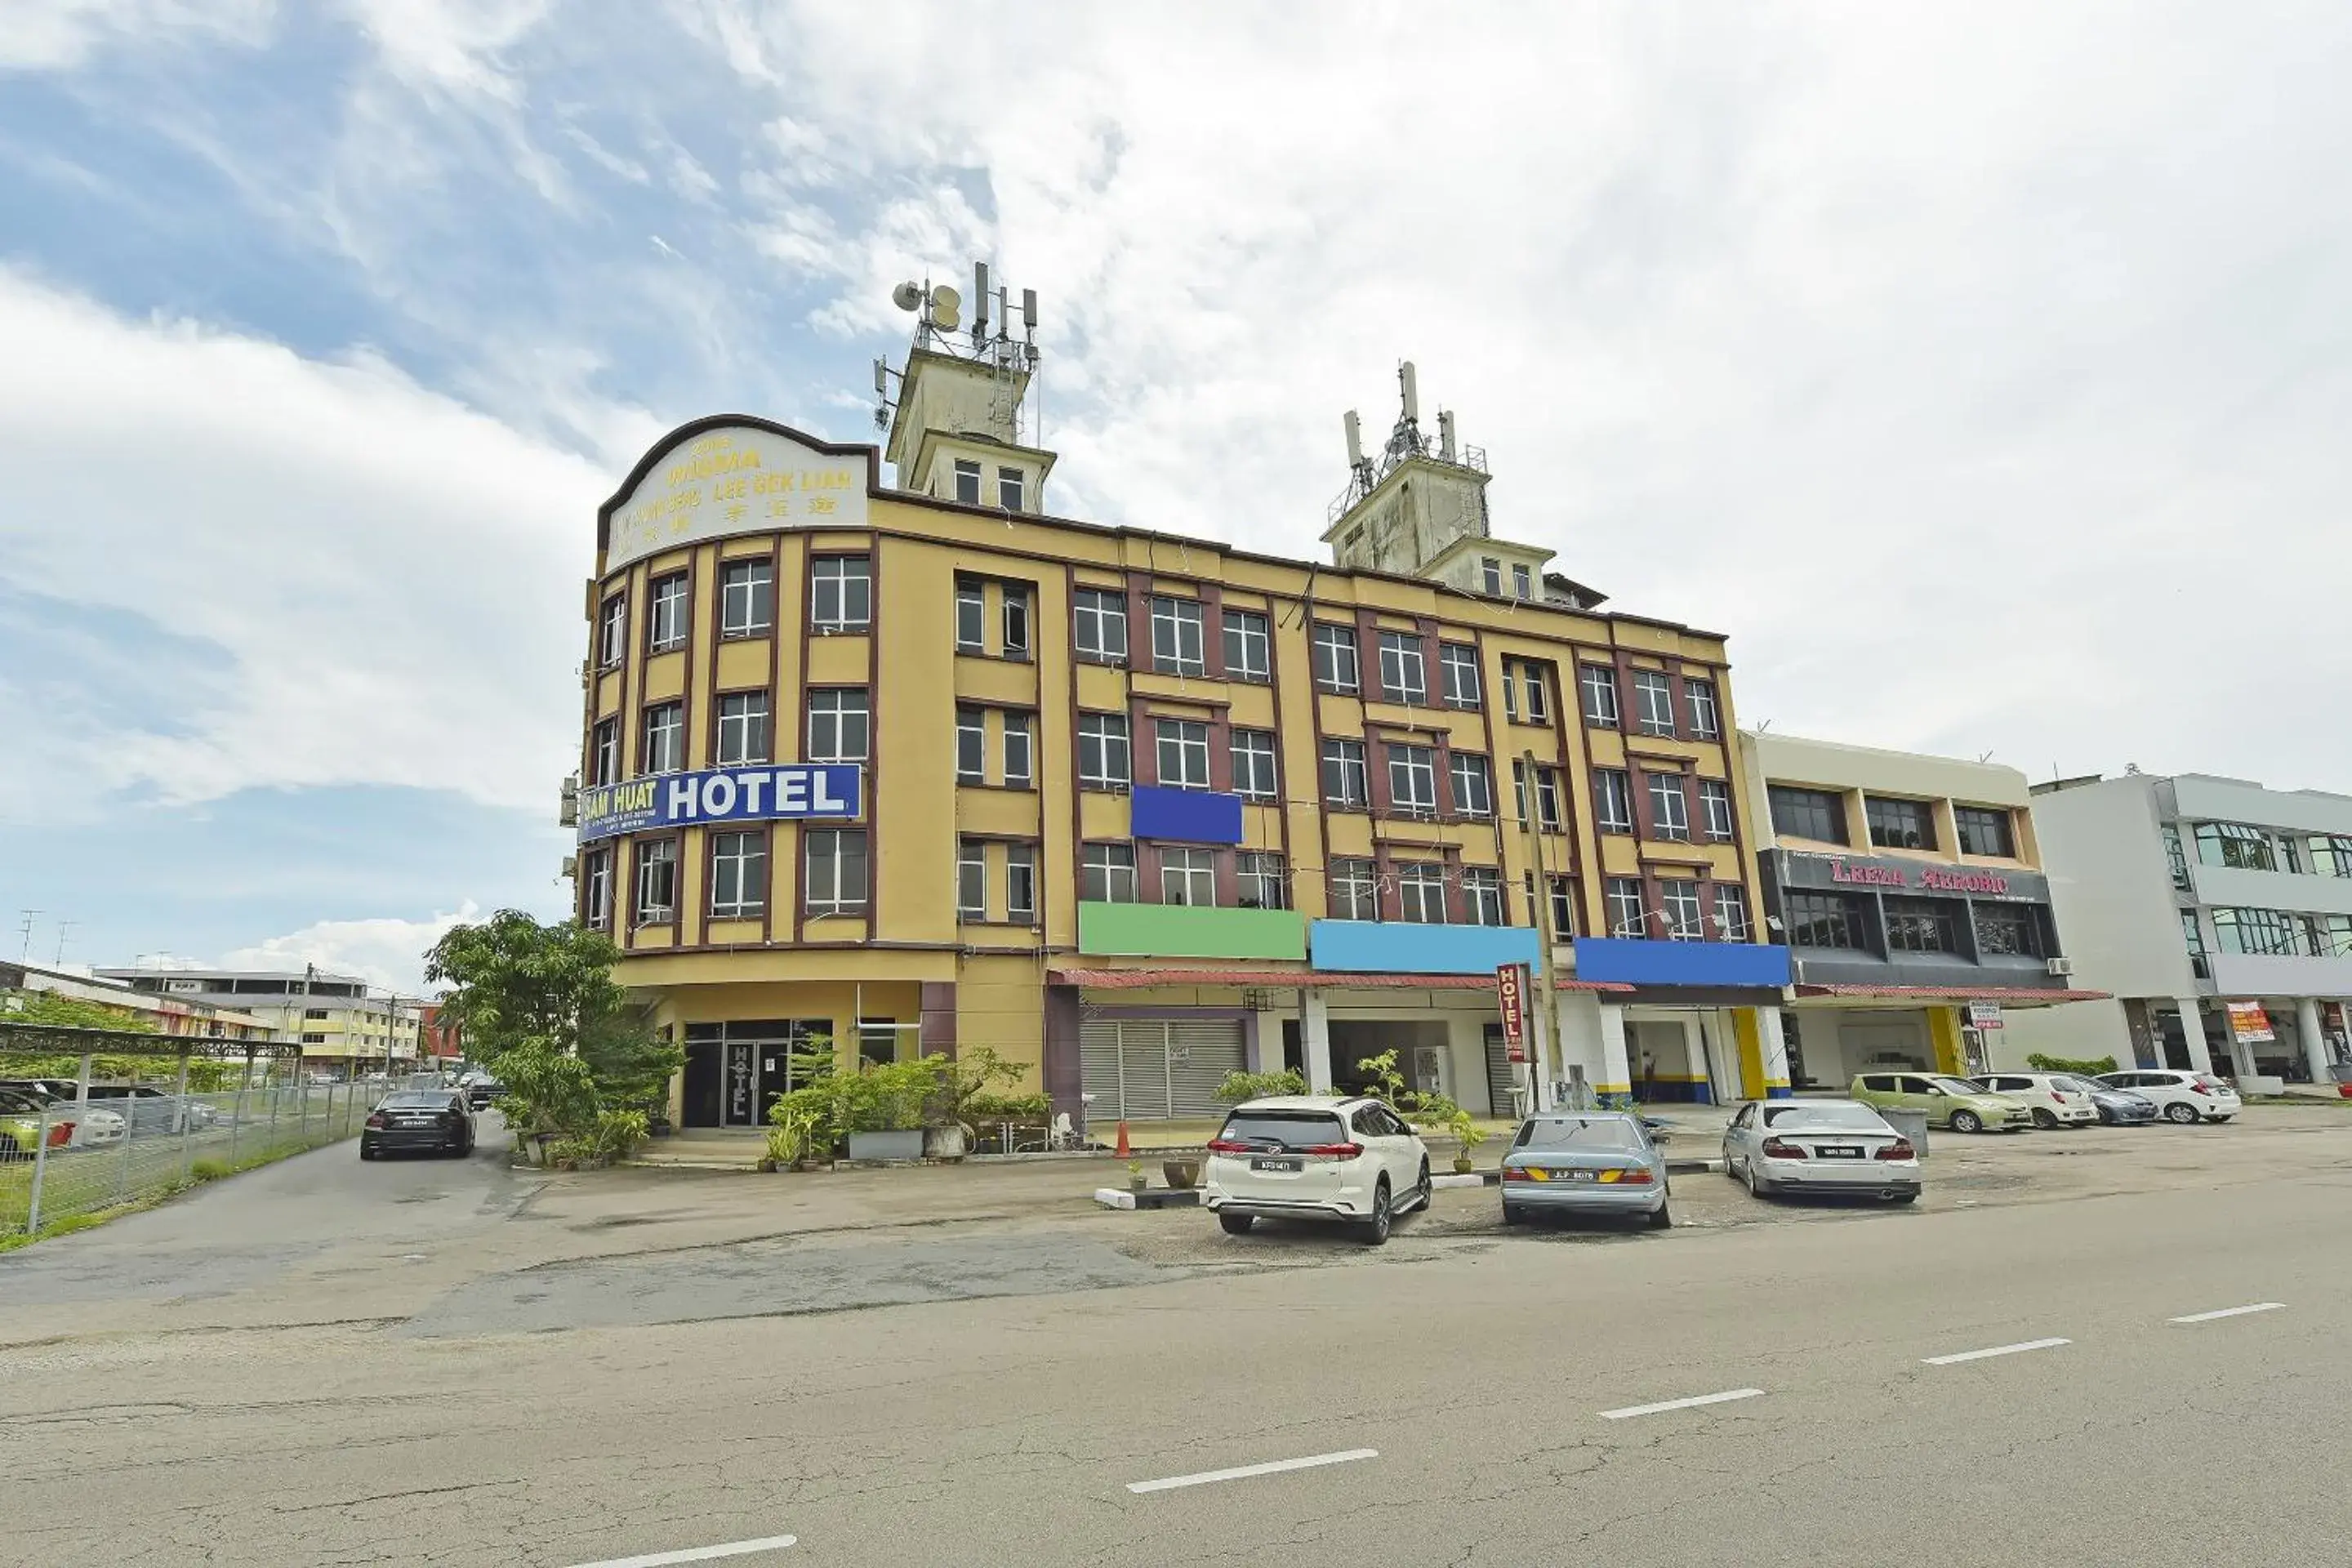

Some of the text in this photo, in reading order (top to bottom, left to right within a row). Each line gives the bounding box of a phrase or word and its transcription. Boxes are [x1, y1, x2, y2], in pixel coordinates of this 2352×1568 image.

[614, 781, 657, 813] HUAT
[668, 770, 844, 819] HOTEL
[1500, 969, 1519, 1036] HOTEL
[733, 1046, 748, 1116] HOTEL
